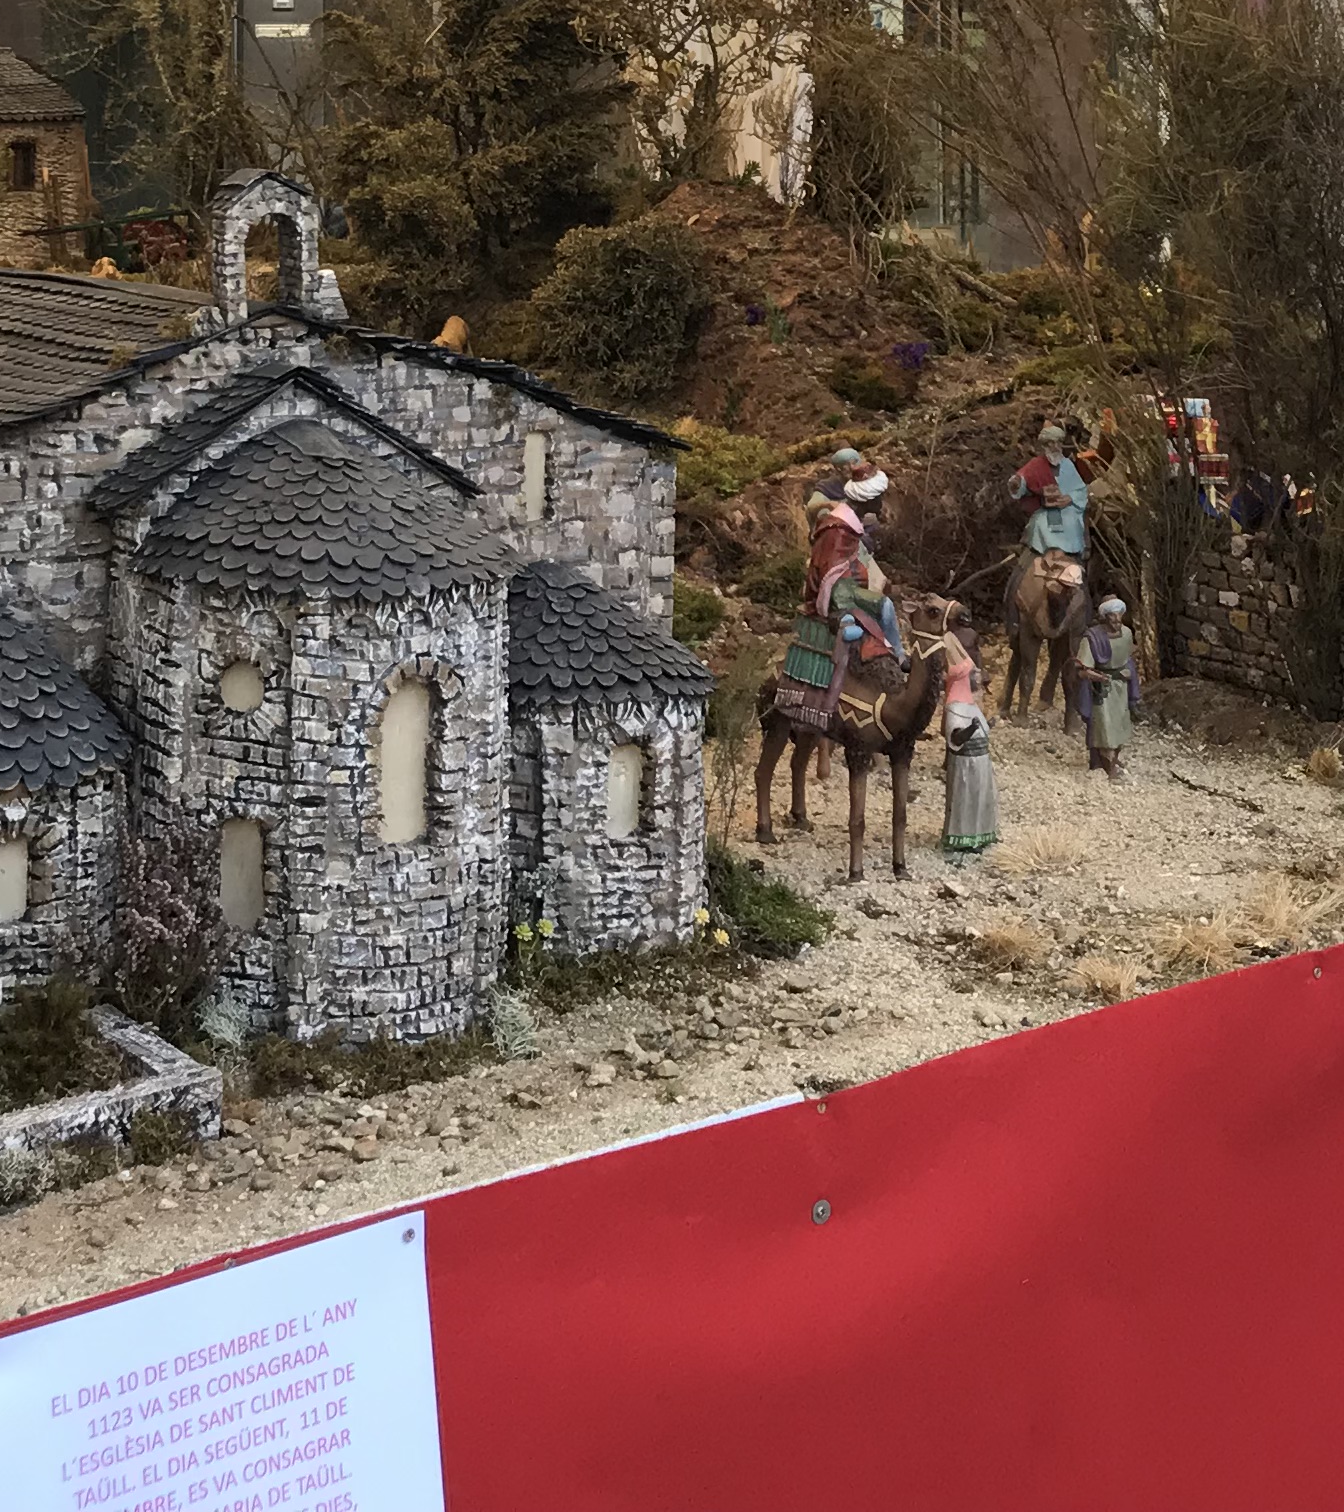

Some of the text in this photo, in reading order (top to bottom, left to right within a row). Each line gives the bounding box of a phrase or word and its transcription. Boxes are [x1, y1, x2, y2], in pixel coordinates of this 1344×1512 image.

[51, 1393, 73, 1418] EL
[78, 1381, 111, 1409] DIA
[116, 1371, 139, 1396] 10
[144, 1360, 169, 1386] DE
[174, 1327, 270, 1377] DESEMBRE
[275, 1318, 298, 1343] DE
[322, 1298, 357, 1327] ANY
[88, 1341, 330, 1440] 1123 VA SER CONSAGRADA
[169, 1418, 194, 1443] DE
[198, 1400, 246, 1434] SANT
[250, 1371, 328, 1414] CLIMENT
[332, 1362, 356, 1387] DE
[73, 1396, 349, 1510] TAÜLL. EL DIA SEGÜENT, 11 DE
[188, 1479, 209, 1504] ES
[212, 1469, 238, 1495] VA
[242, 1428, 351, 1483] CONSAGRAR
[268, 1481, 292, 1508] DE
[296, 1462, 353, 1496] TAÜLL.
